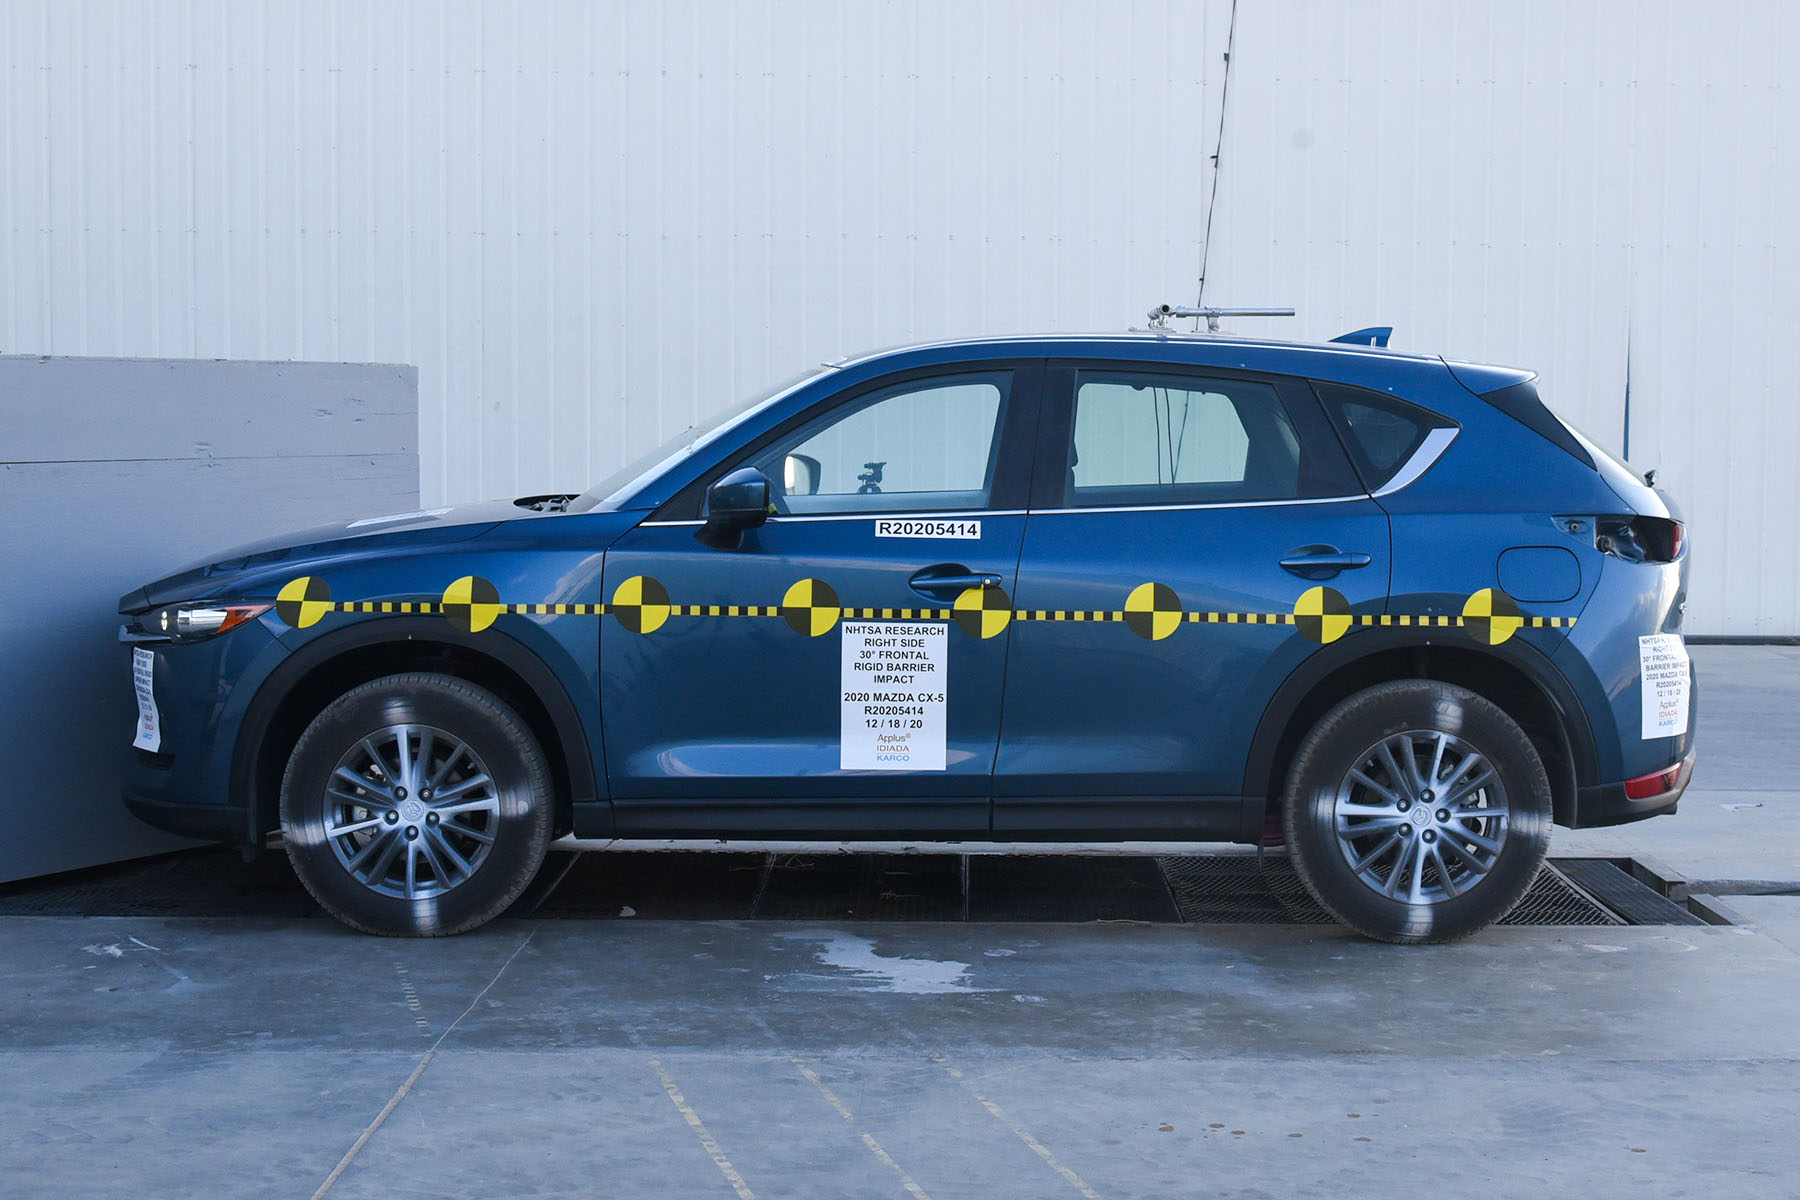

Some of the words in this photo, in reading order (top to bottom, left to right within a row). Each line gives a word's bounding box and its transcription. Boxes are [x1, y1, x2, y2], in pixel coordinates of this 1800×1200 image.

[879, 522, 977, 536] R20205414
[845, 625, 882, 635] NHTSA
[885, 626, 945, 636] RESEARCH
[864, 638, 898, 647] RIGHT
[900, 638, 925, 648] SIDE
[878, 650, 930, 660] FRONTAL
[853, 662, 883, 672] RIGID
[886, 662, 935, 672] BARRIER
[873, 674, 915, 684] IMPACT
[844, 692, 870, 702] 2020
[873, 692, 915, 702] MAZDA
[917, 692, 945, 703] CX-5
[864, 705, 924, 716] R20205414
[865, 718, 878, 729] 12
[888, 718, 901, 729] 18
[910, 718, 923, 729] 20
[877, 754, 910, 762] KARCO
